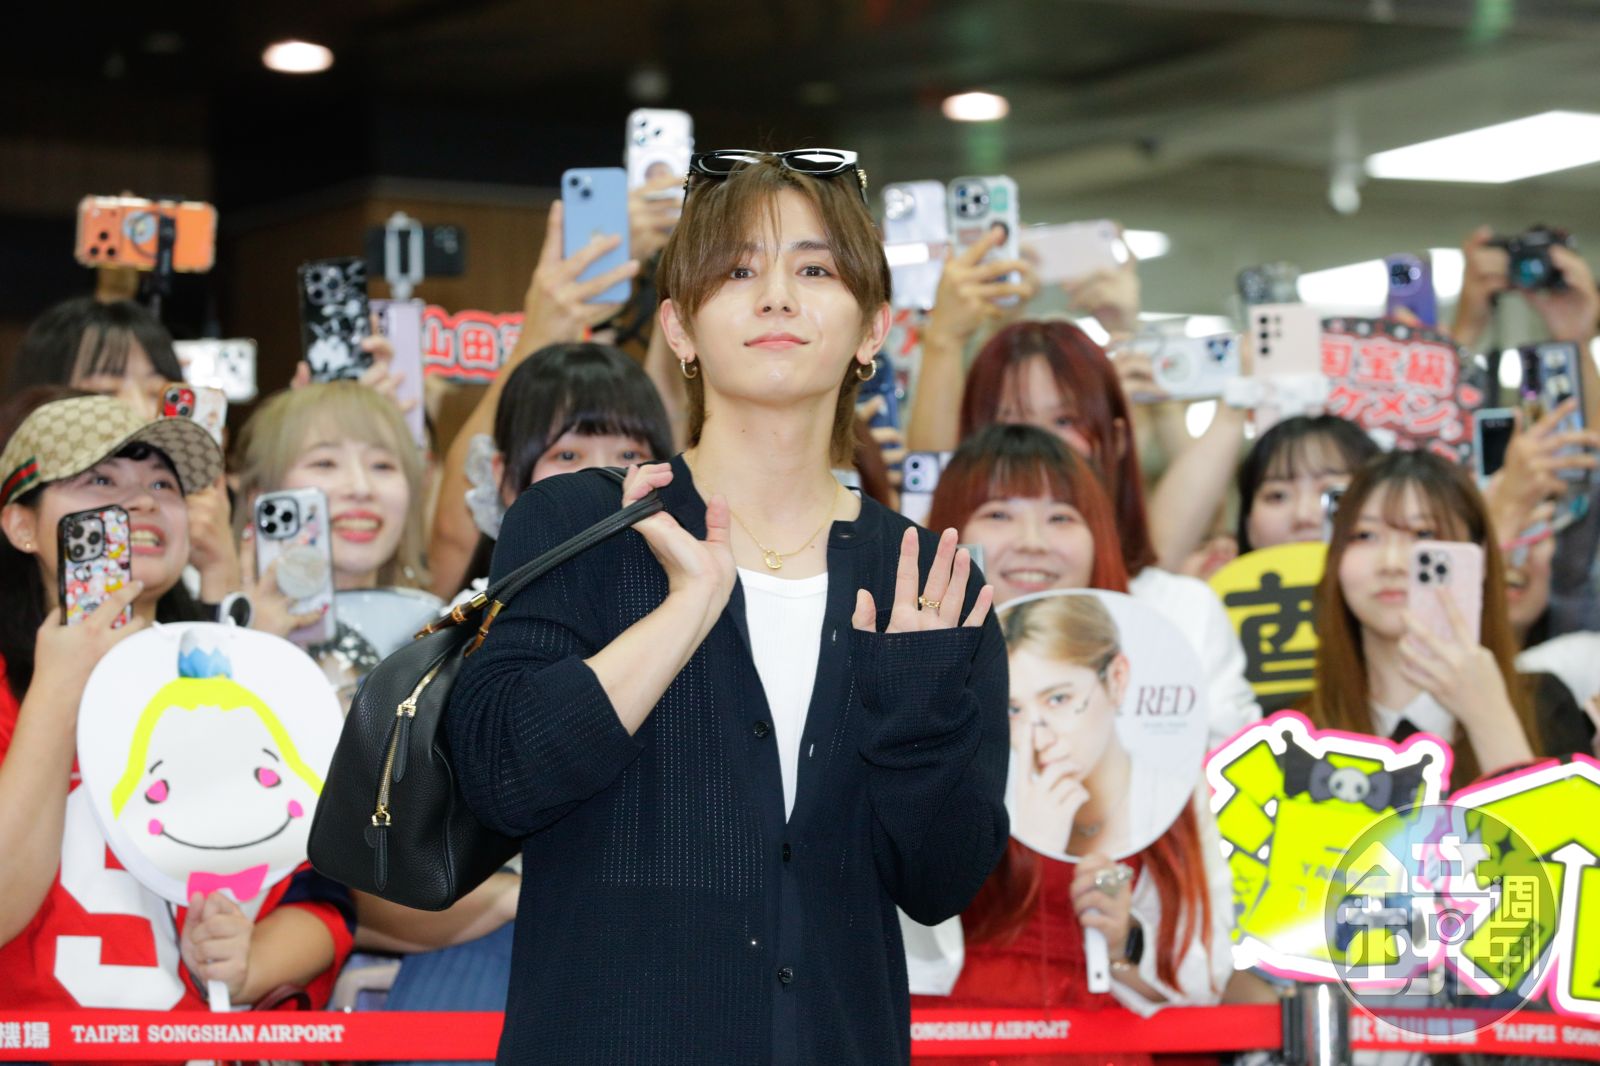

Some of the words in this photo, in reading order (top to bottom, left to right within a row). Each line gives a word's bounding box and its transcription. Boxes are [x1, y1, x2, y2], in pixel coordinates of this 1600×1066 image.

[421, 323, 521, 361] 山田
[1135, 685, 1197, 717] RED
[71, 1024, 140, 1043] TAIPEI
[147, 1024, 255, 1043] SONGSHAN
[257, 1024, 345, 1043] AIRPORT
[994, 1020, 1071, 1039] AIRPORT
[1494, 1023, 1557, 1043] TAIPEI
